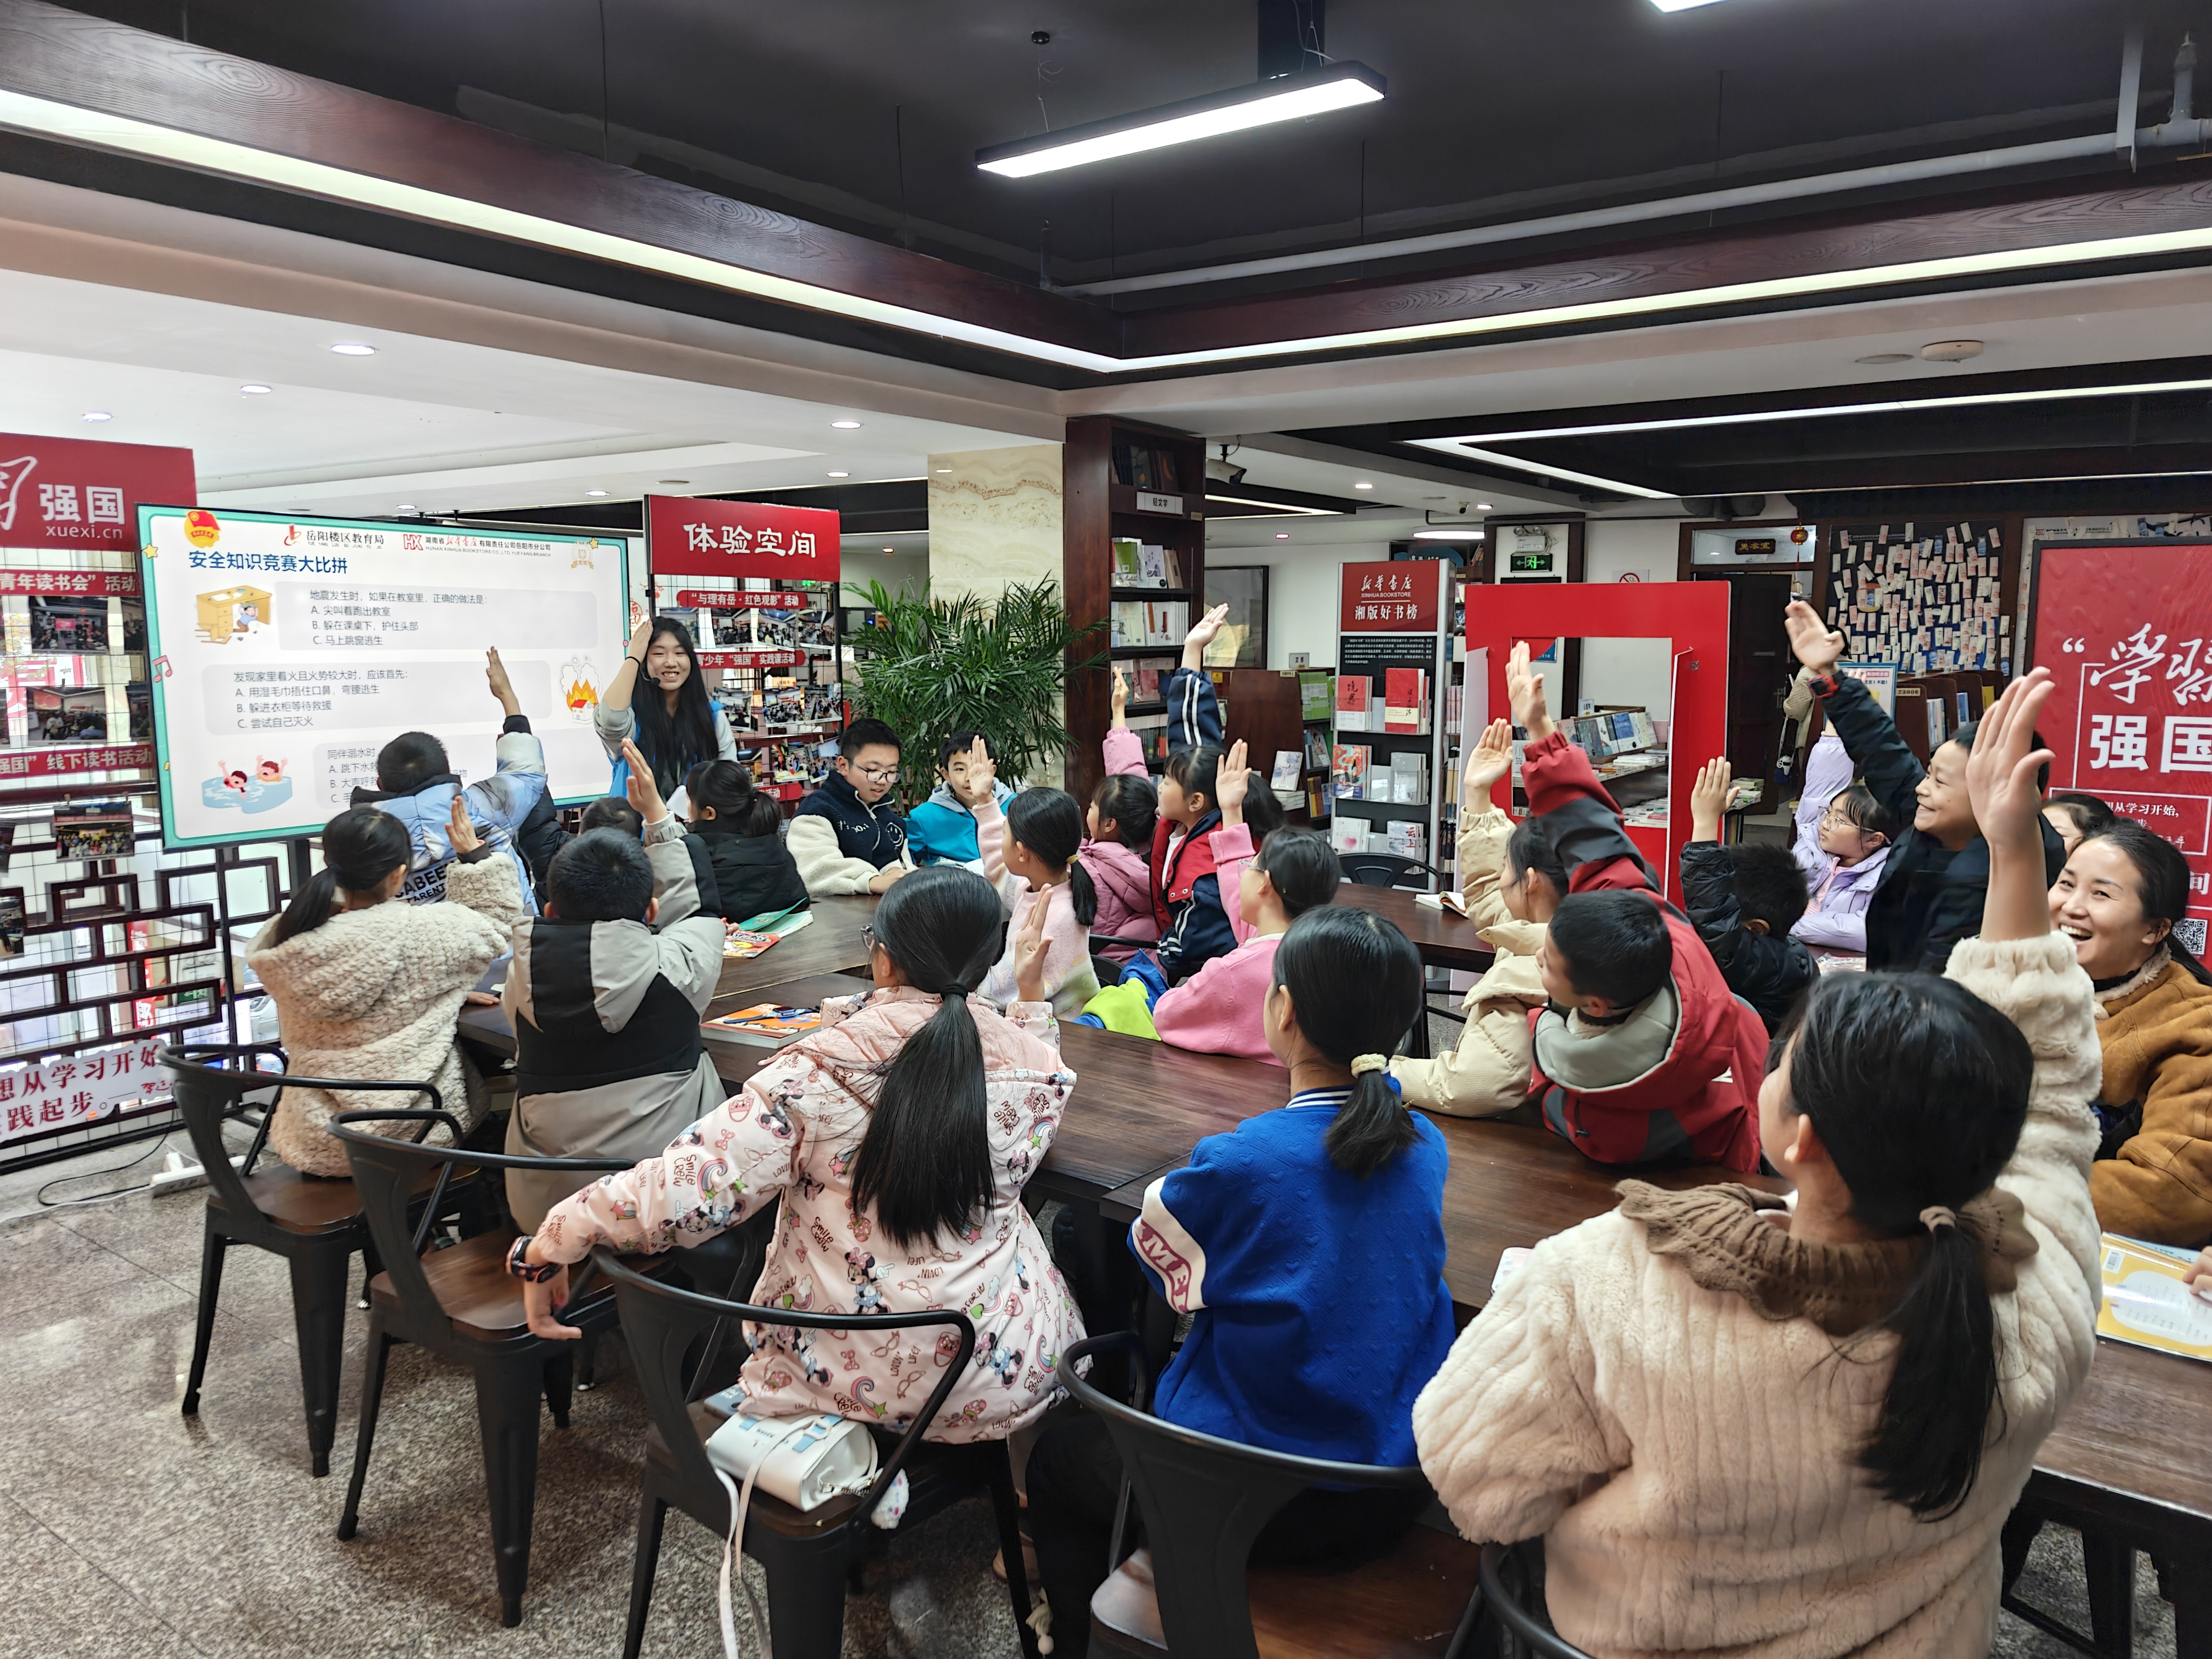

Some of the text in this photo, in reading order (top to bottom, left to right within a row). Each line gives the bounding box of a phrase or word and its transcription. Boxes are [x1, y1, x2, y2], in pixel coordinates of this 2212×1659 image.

[38, 483, 125, 525] 强国
[46, 524, 123, 539] xuexi.cn
[306, 530, 384, 544] 岳阳楼区教育局
[683, 523, 816, 558] 体验空间
[189, 550, 347, 574] 安全知识竞赛大比拼
[105, 575, 136, 592] 活动
[785, 595, 799, 606] 活动
[323, 605, 391, 617] 尖叫着跑出教室
[1354, 604, 1418, 621] 湘版好书榜
[325, 635, 383, 646] 马上跳窗逃生
[249, 700, 333, 713] 躲进衣柜等待救援
[251, 716, 314, 729] 尝试自己灭火
[2089, 714, 2212, 773] 强国
[47, 748, 152, 771] 线下读书活动
[327, 747, 375, 759] 同伴溺水时
